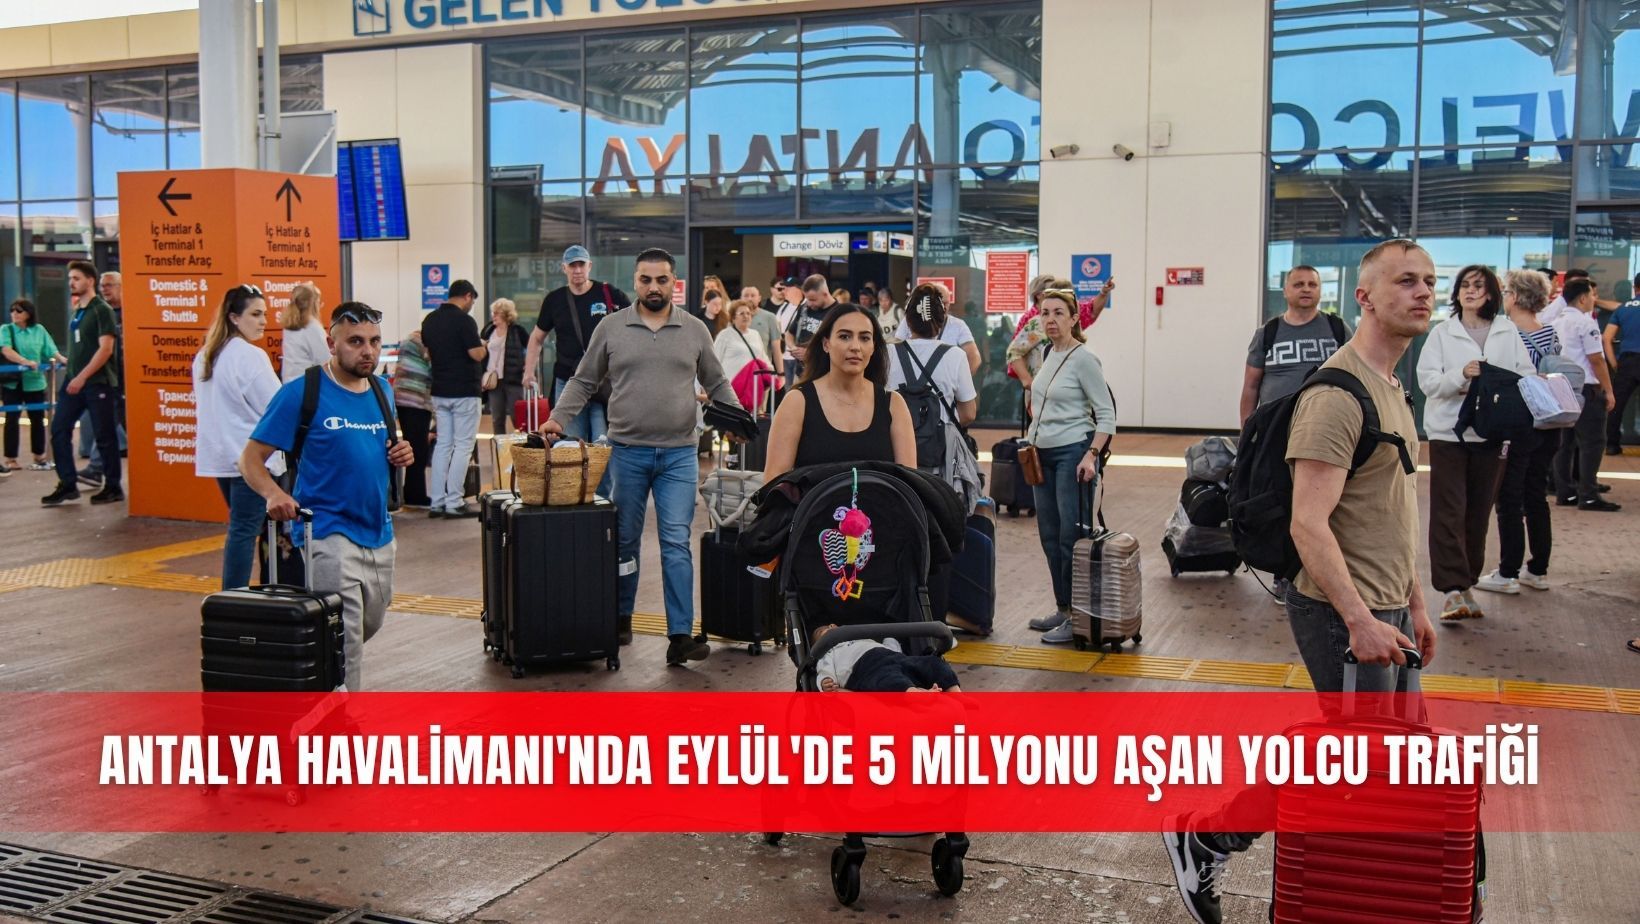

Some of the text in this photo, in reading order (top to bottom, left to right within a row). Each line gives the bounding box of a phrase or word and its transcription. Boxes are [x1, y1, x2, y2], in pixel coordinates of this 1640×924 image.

[151, 221, 203, 237] İç Hatlar &
[276, 226, 301, 238] Hatlar
[304, 227, 310, 238] &
[153, 238, 204, 250] Terminal 1
[267, 240, 311, 253] Terminal 1
[779, 241, 812, 251] Change
[818, 240, 843, 249] Döviz
[145, 255, 212, 269] Transfer Araç
[260, 256, 318, 270] Transfer Araç
[150, 279, 208, 291] Domestic &
[154, 294, 206, 307] Terminal 1
[162, 310, 198, 323] Shuttle
[152, 334, 199, 347] Domestic
